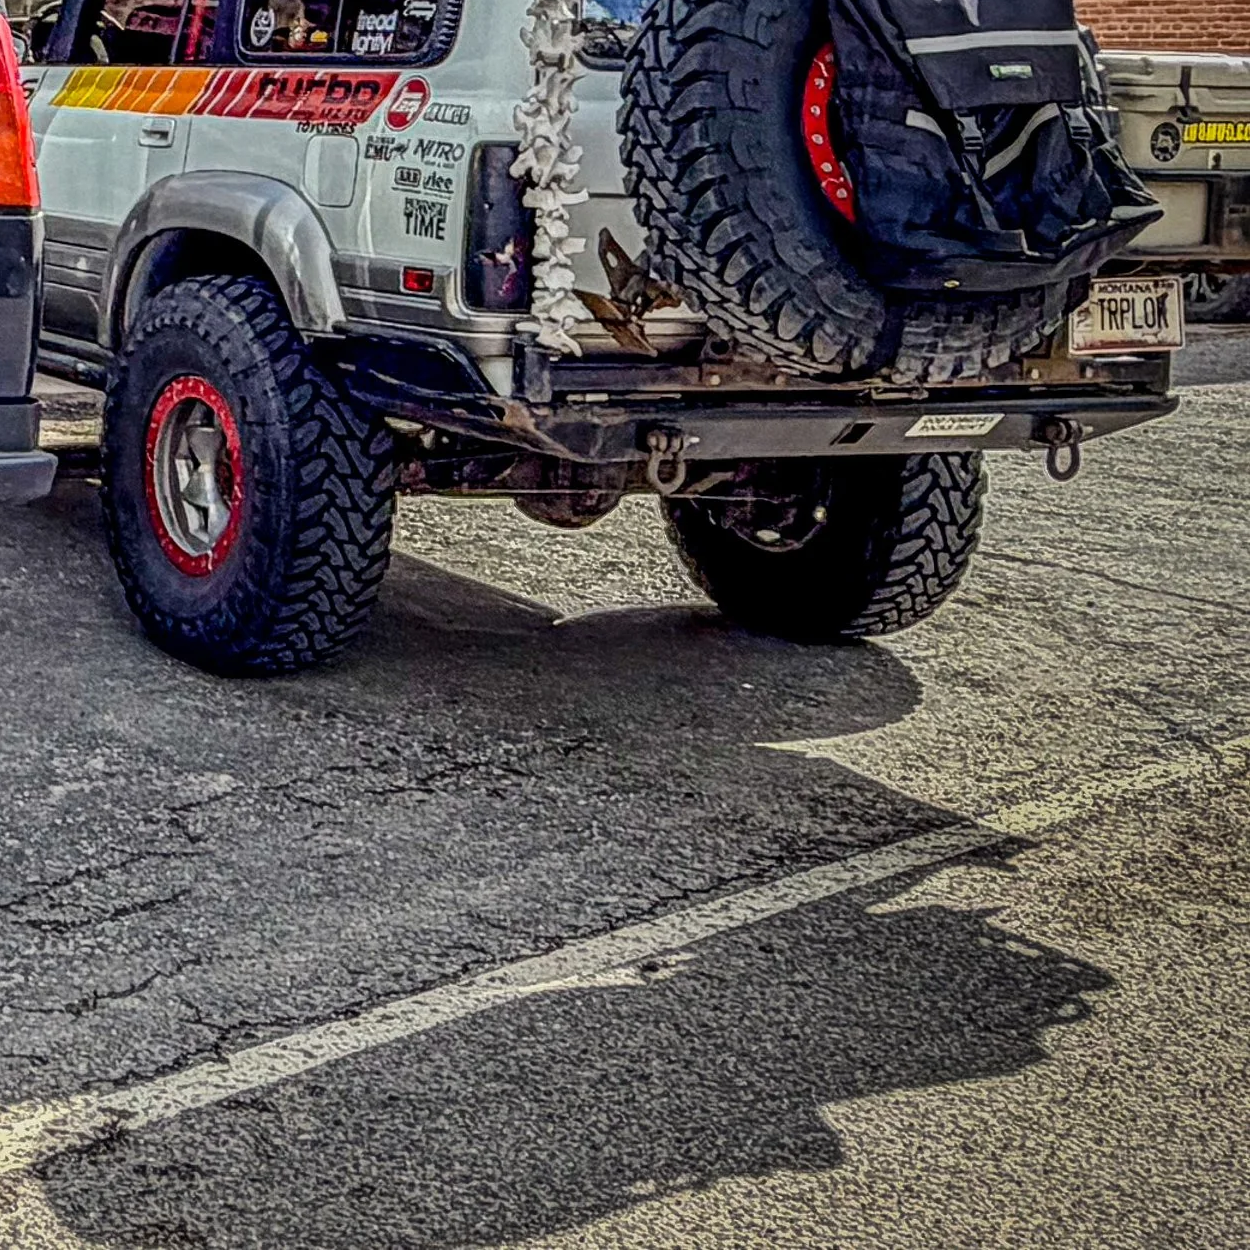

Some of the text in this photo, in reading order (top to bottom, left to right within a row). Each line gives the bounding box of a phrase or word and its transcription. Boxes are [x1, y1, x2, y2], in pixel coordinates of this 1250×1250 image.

[257, 72, 381, 105] turbo
[364, 143, 392, 162] EMU
[413, 138, 466, 163] NITRO
[404, 210, 448, 241] TIME
[1098, 294, 1170, 331] TRPLOK
